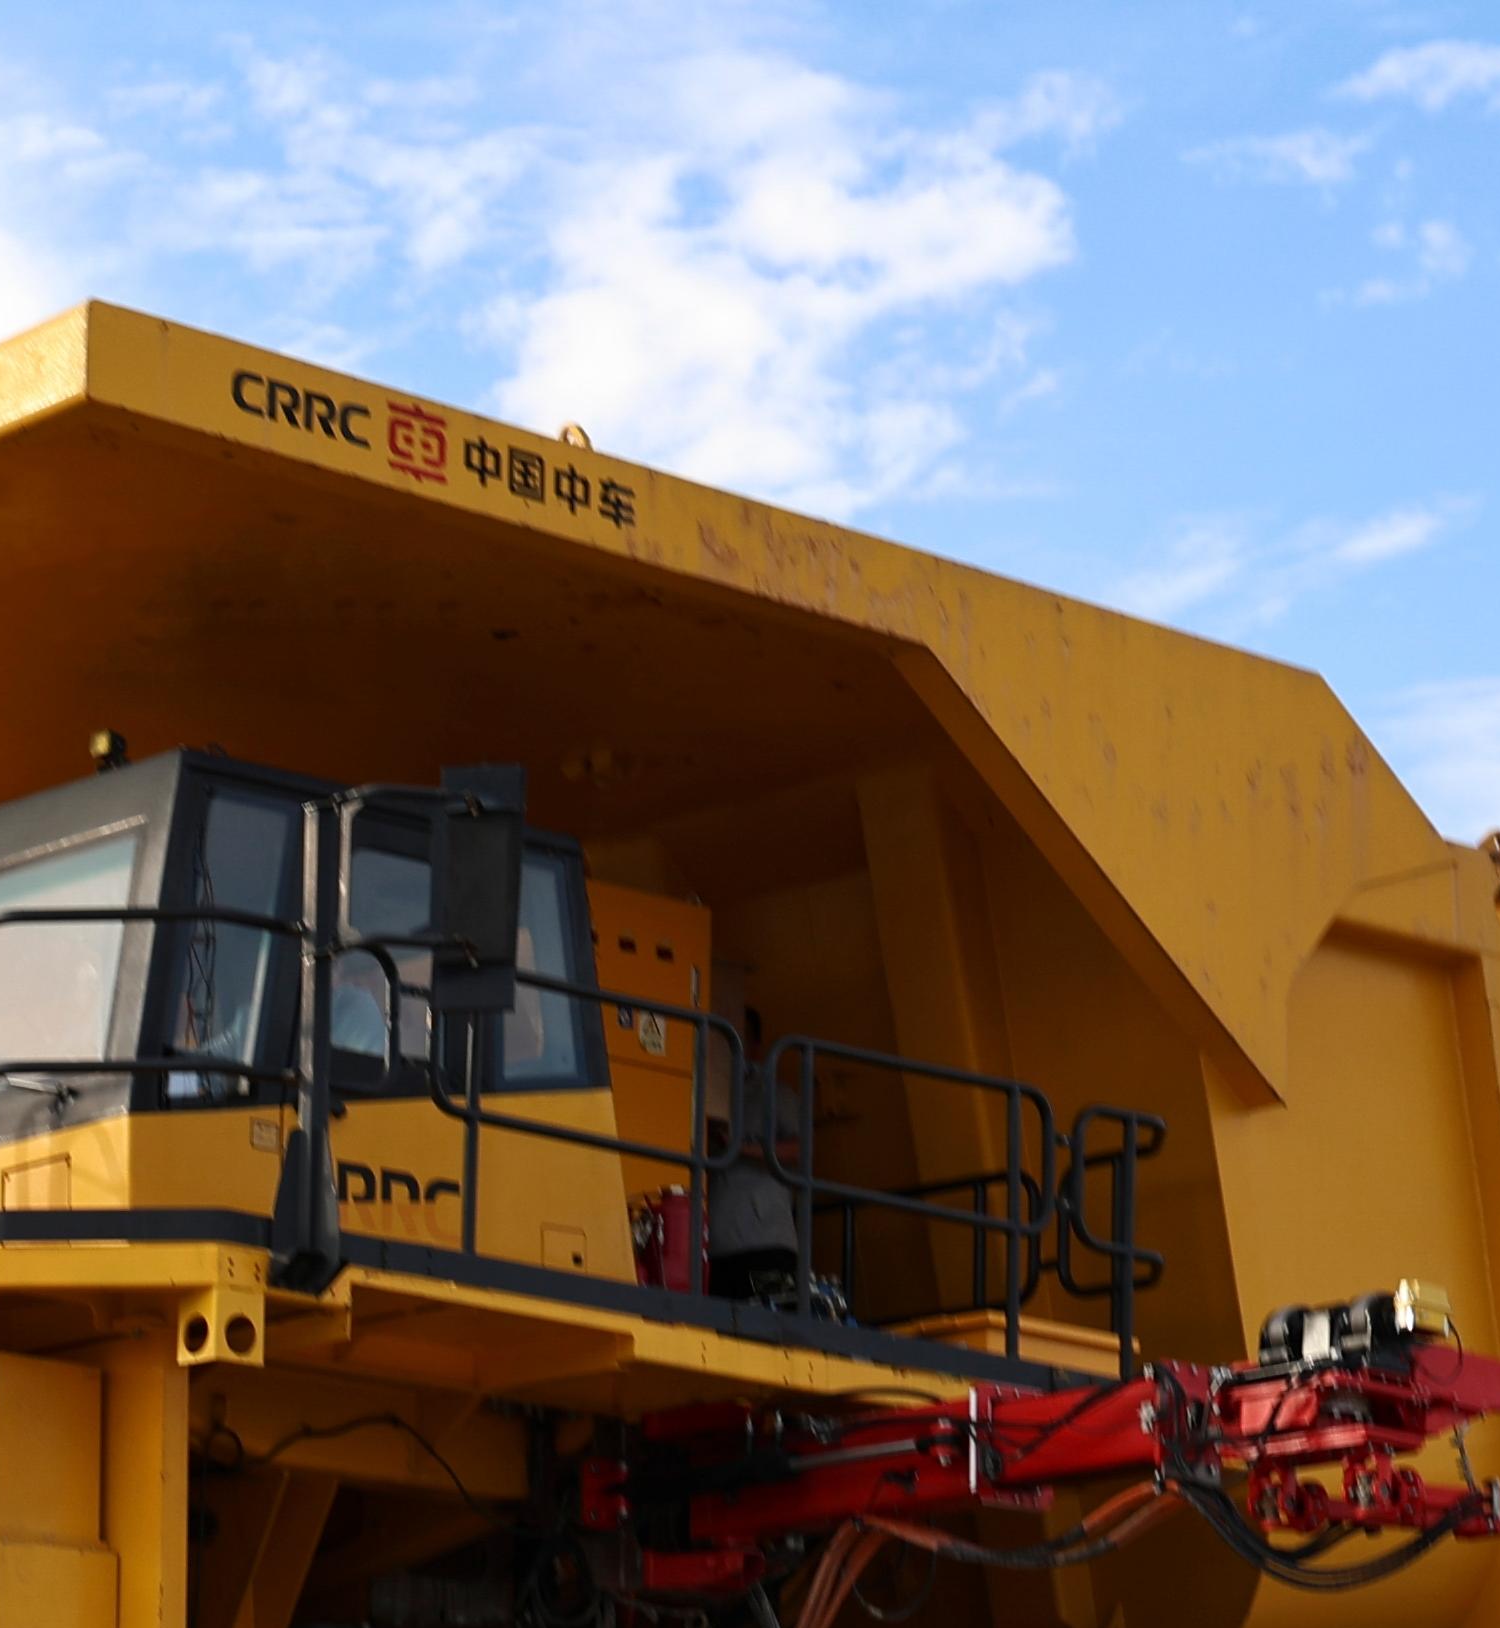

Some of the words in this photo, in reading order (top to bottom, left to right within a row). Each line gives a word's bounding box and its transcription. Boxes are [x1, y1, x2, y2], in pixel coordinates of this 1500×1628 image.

[231, 368, 371, 449] CRRC
[463, 435, 636, 529] 中国中车
